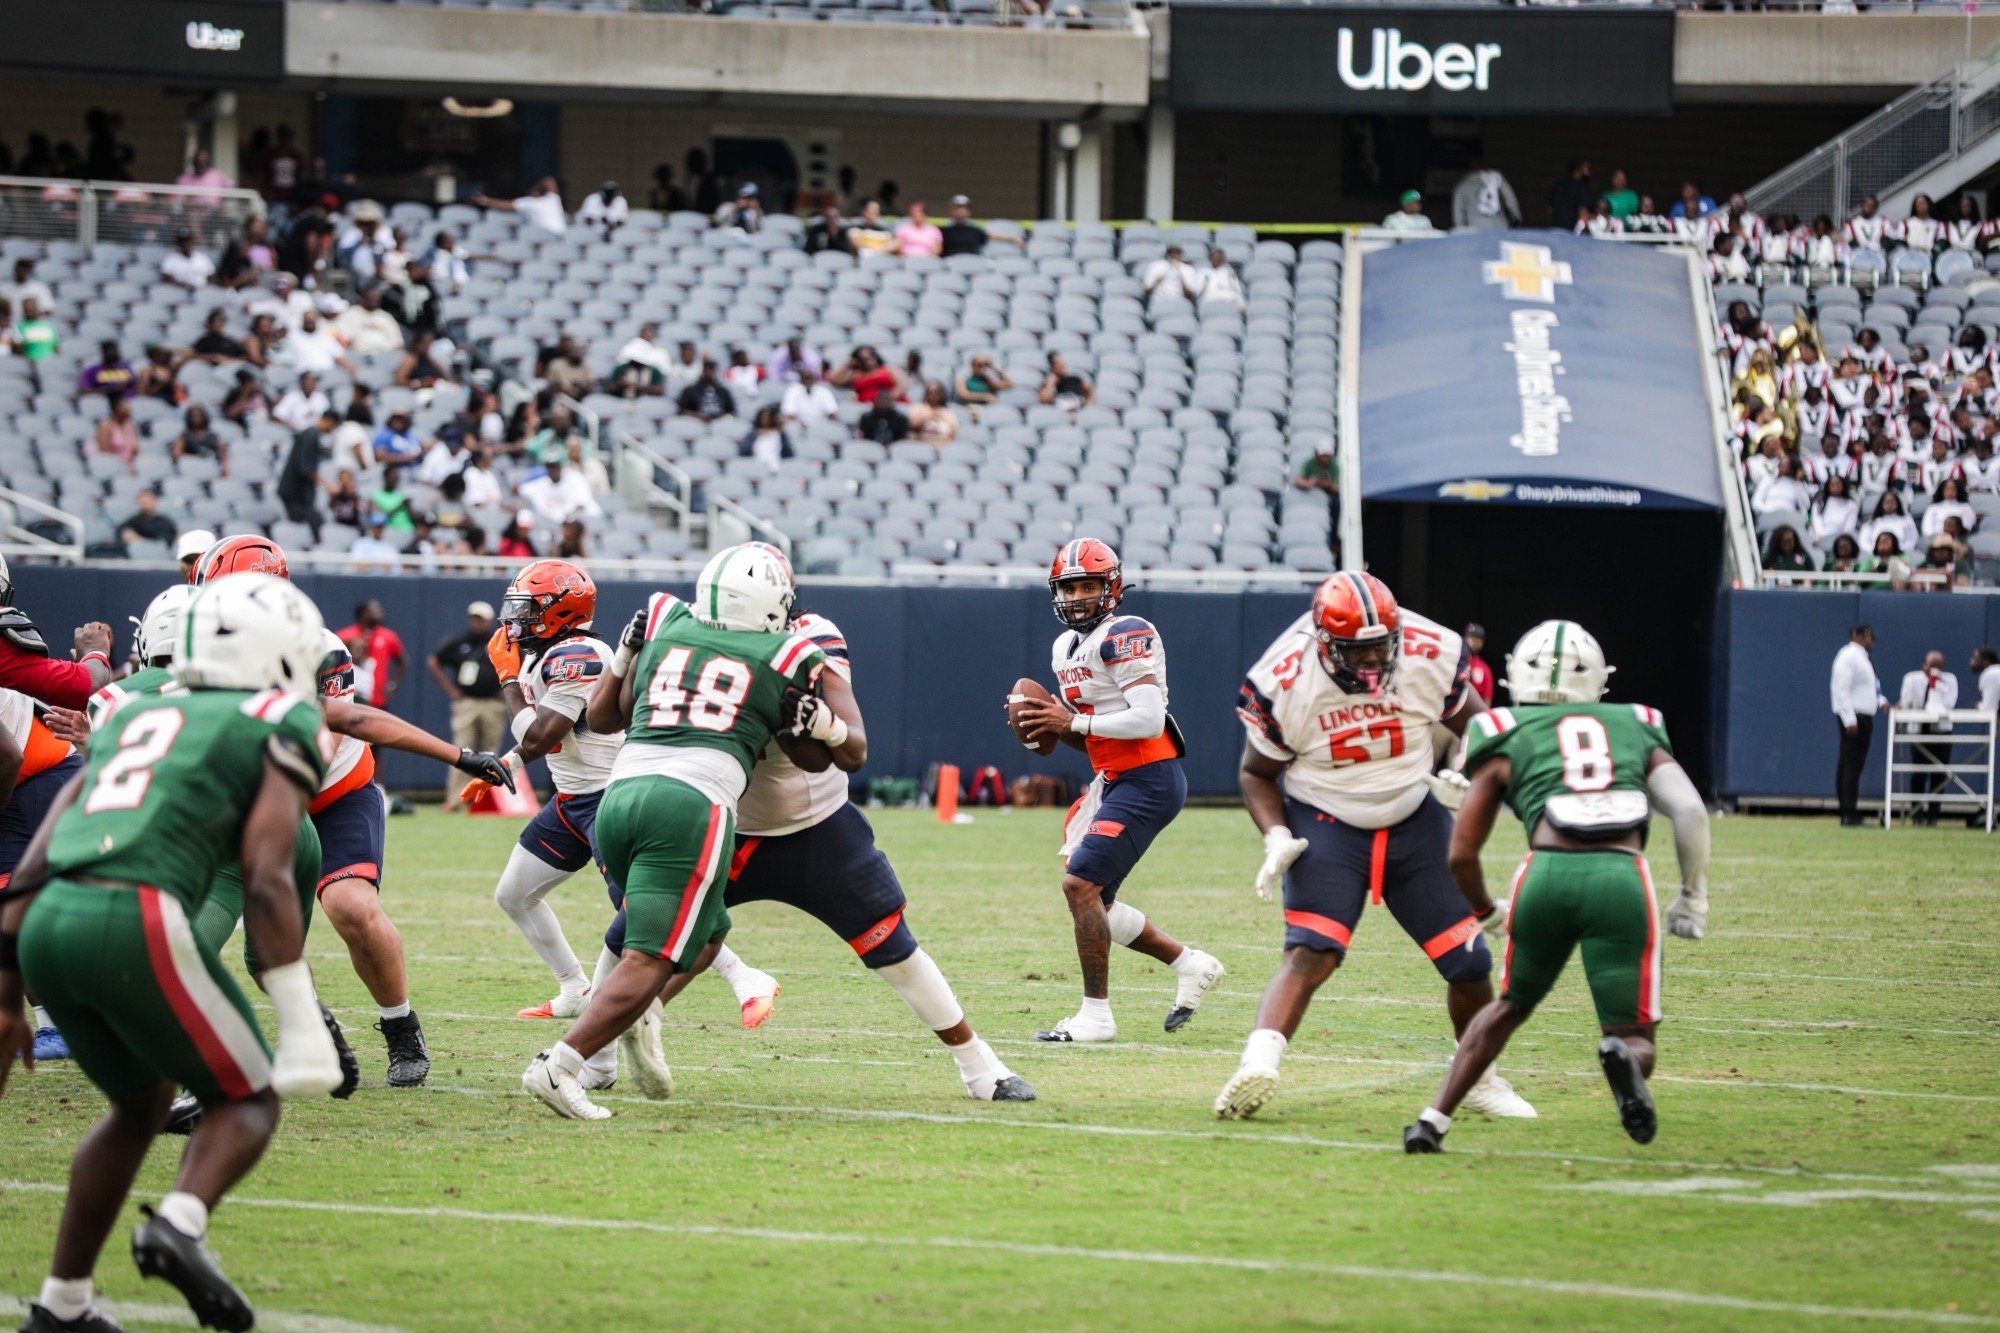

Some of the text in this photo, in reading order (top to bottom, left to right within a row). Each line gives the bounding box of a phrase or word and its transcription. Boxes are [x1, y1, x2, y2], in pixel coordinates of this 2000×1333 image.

[186, 21, 244, 51] Uber
[1337, 27, 1501, 91] Uber
[1113, 633, 1147, 659] LU
[1403, 626, 1442, 660] 57
[551, 656, 585, 682] LU
[647, 646, 753, 733] 48
[1065, 686, 1095, 716] 5
[1318, 700, 1404, 732] LINCOLN
[83, 706, 185, 815] 2
[1329, 718, 1404, 769] 57
[1556, 713, 1615, 792] 8
